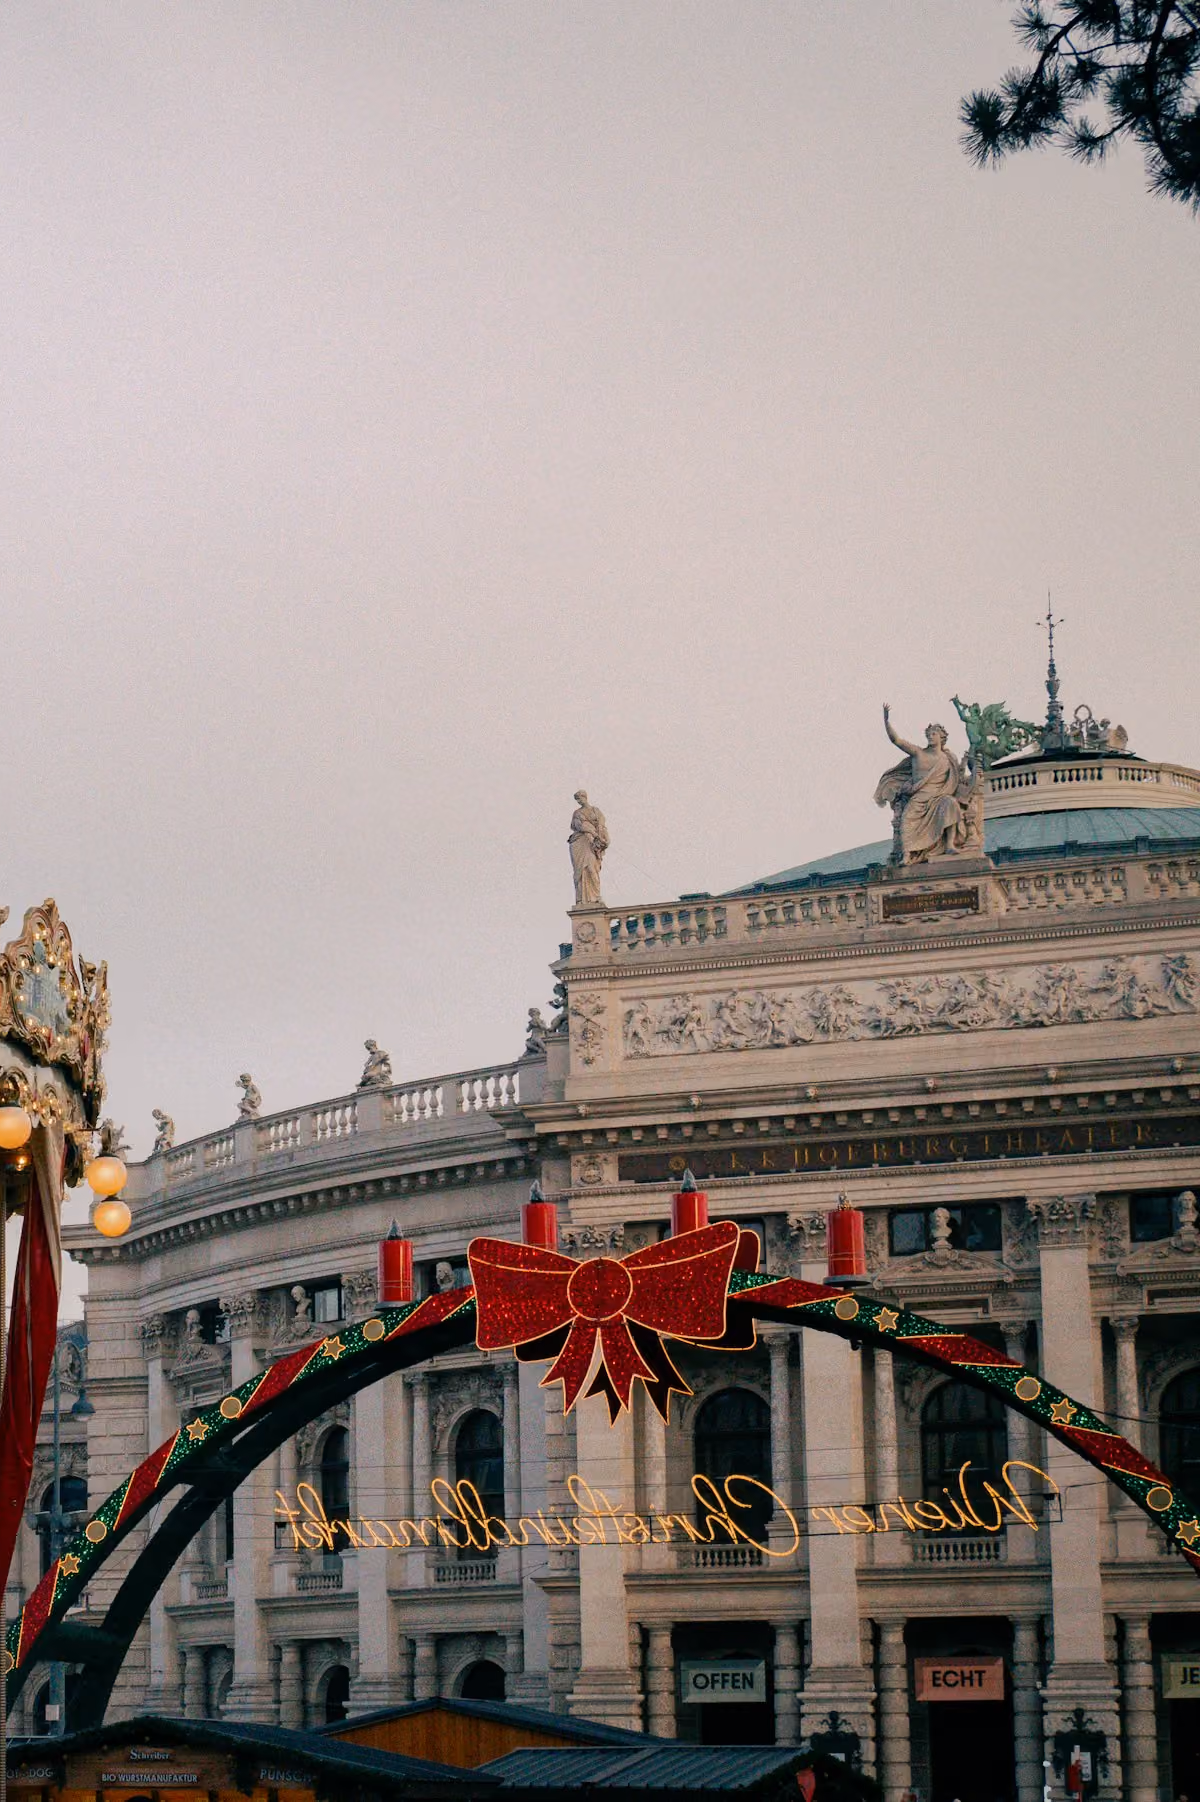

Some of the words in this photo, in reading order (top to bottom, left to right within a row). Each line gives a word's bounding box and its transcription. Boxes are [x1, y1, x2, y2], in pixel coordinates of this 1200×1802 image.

[692, 1671, 754, 1690] OFFEN
[931, 1669, 987, 1688] ECHT
[1180, 1666, 1200, 1684] JE
[101, 1773, 116, 1782] BIO
[118, 1773, 198, 1783] WURSTMANUFAKTUR
